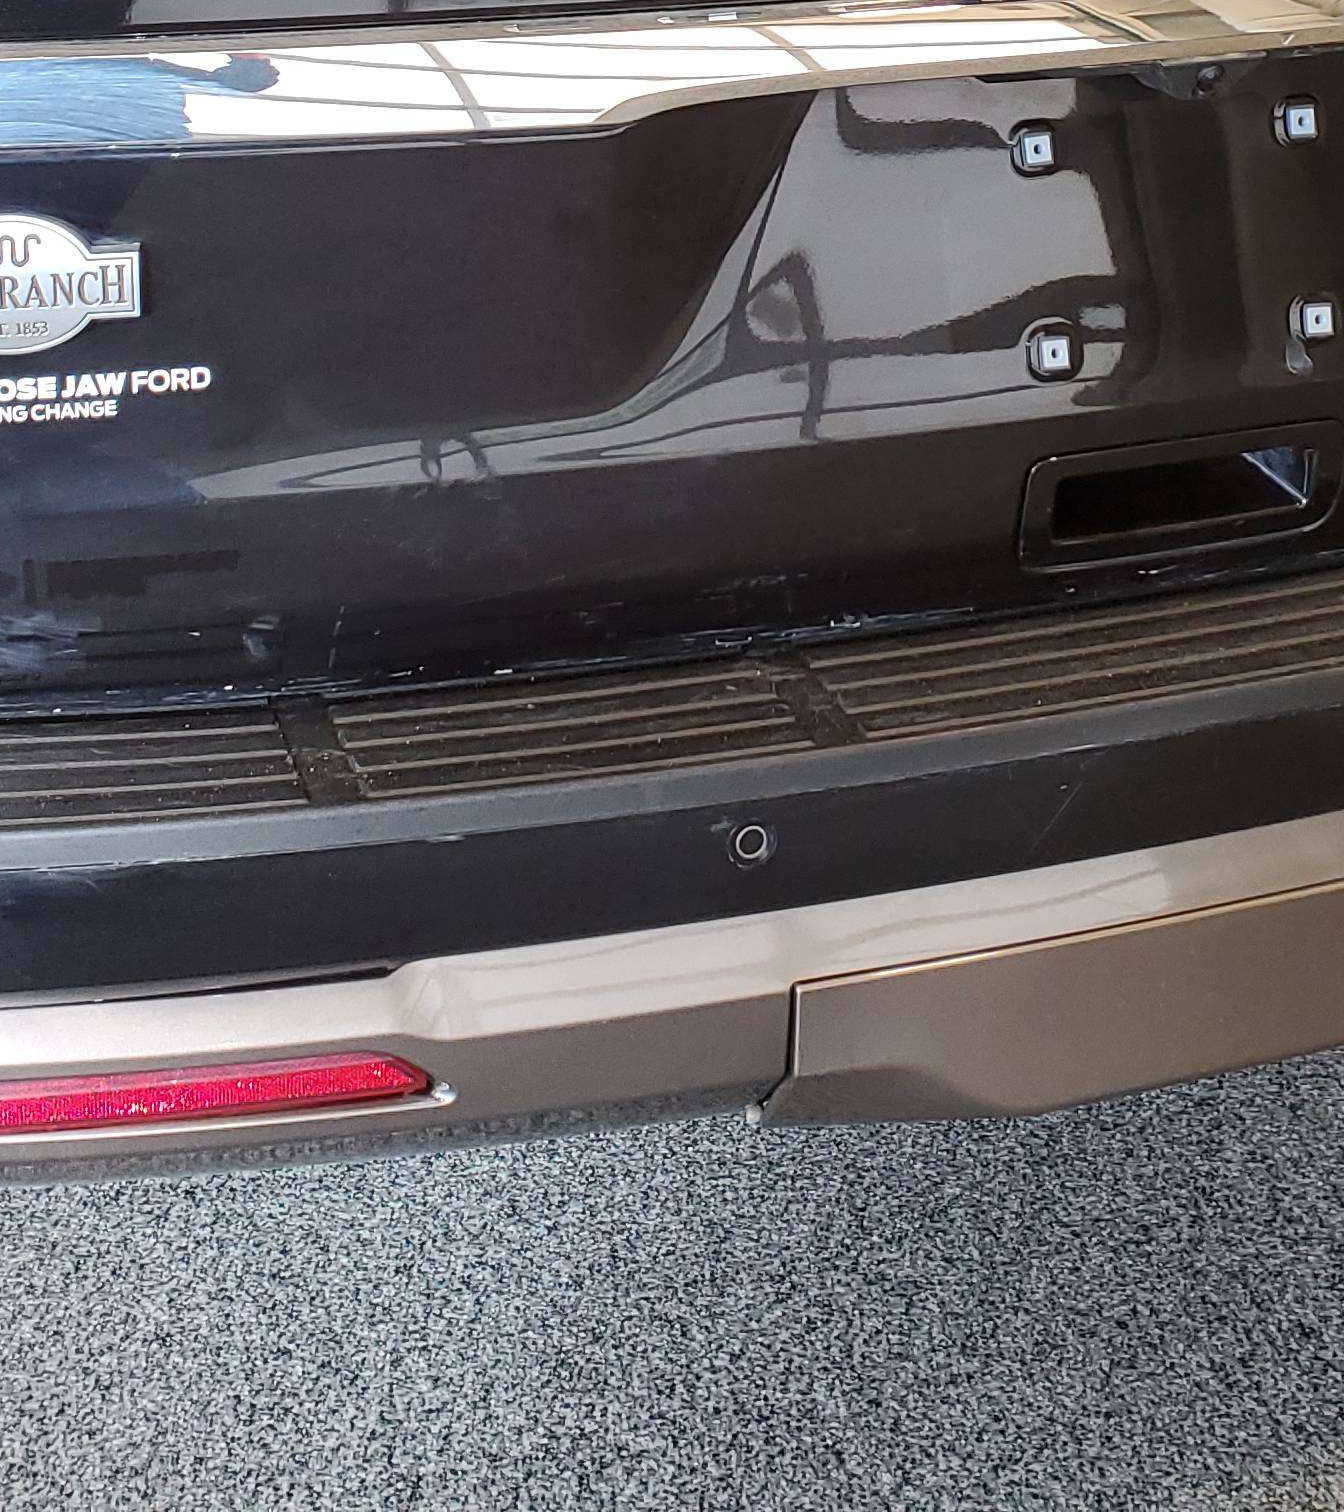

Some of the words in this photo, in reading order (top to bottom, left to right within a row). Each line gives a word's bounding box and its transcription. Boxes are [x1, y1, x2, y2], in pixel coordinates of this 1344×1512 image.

[16, 321, 49, 335] 1853
[62, 371, 126, 397] JAW
[131, 366, 211, 394] FORD
[30, 399, 118, 421] CHANGE
